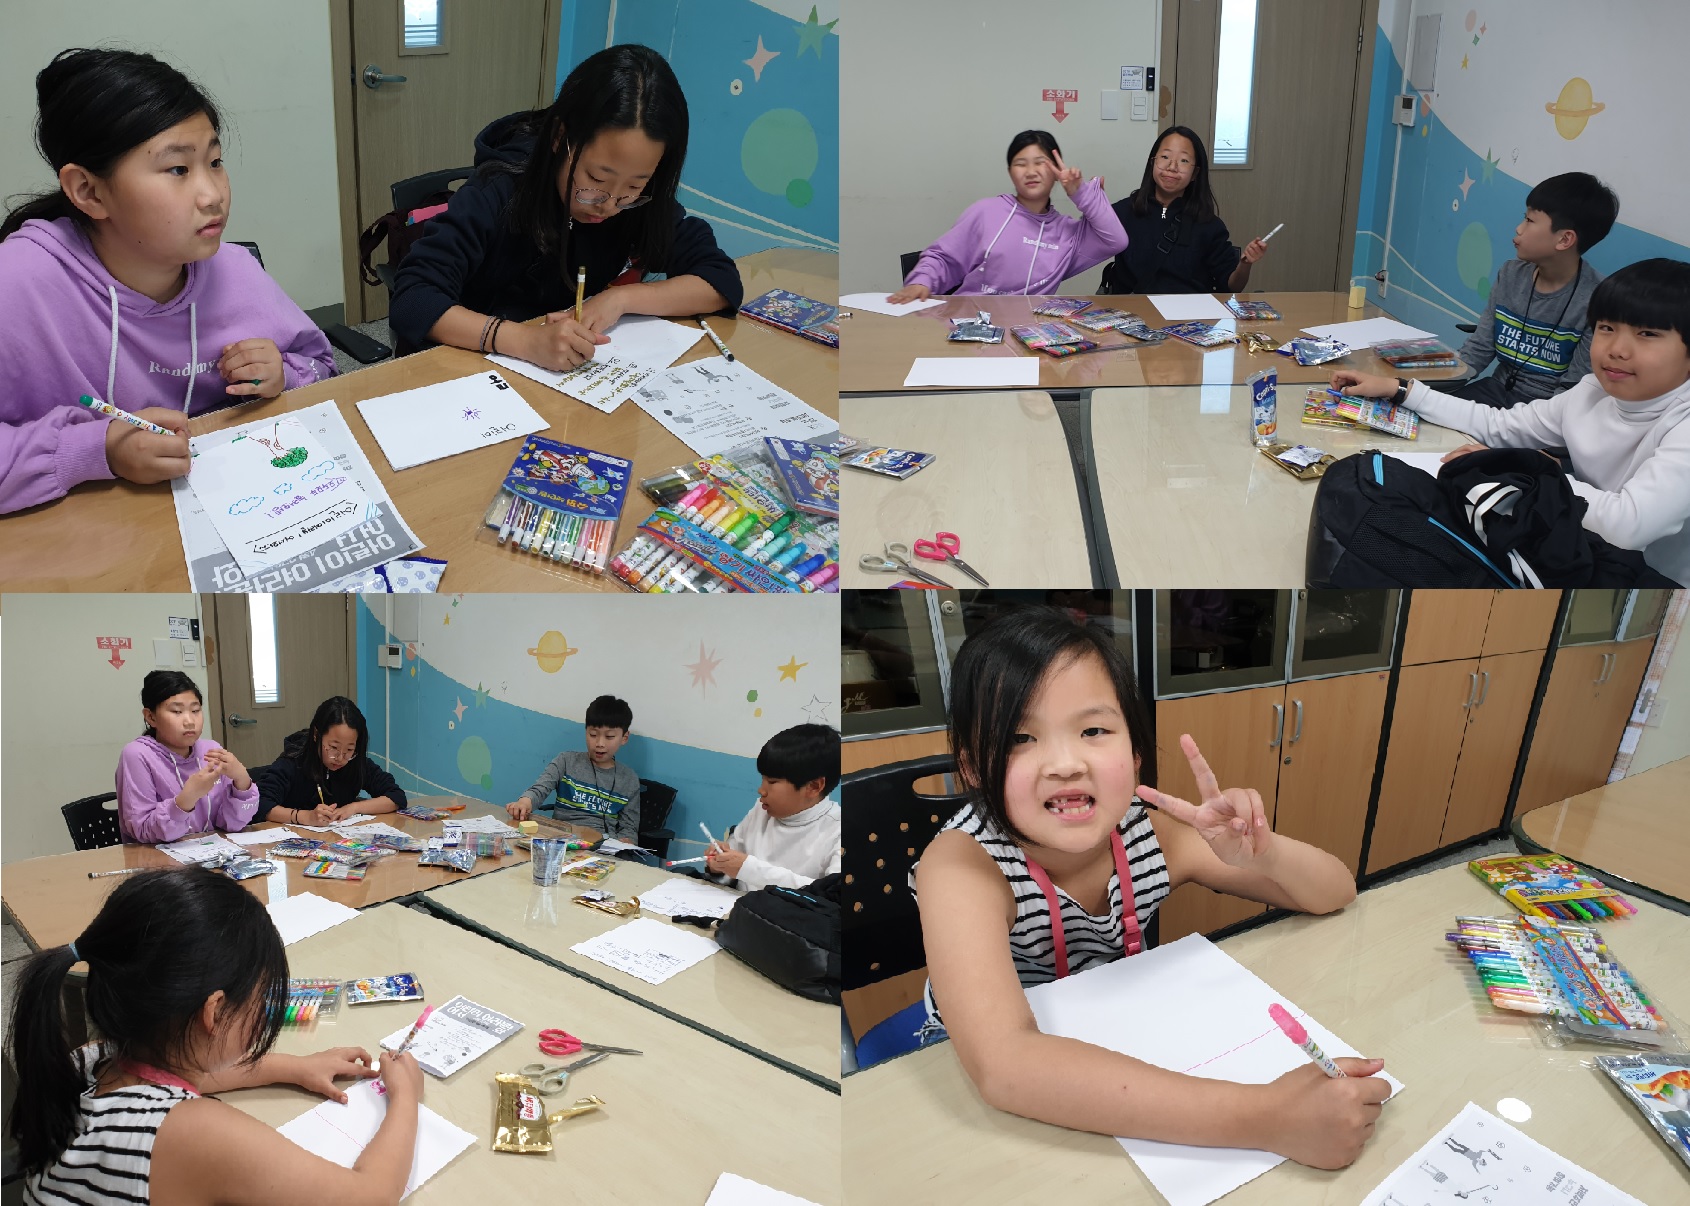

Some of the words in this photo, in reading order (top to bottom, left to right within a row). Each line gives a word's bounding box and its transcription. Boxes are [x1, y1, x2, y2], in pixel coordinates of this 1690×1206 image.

[1046, 90, 1075, 99] 소화기
[1501, 324, 1522, 340] THE
[1525, 334, 1561, 352] FUTURE
[1497, 335, 1539, 356] STARTS
[1540, 349, 1561, 363] NOW
[148, 359, 216, 377] Randmy
[1256, 383, 1277, 401] Capri-S
[481, 423, 517, 440] 어린이
[315, 534, 396, 575] 어린이
[455, 1001, 483, 1018] 어린이
